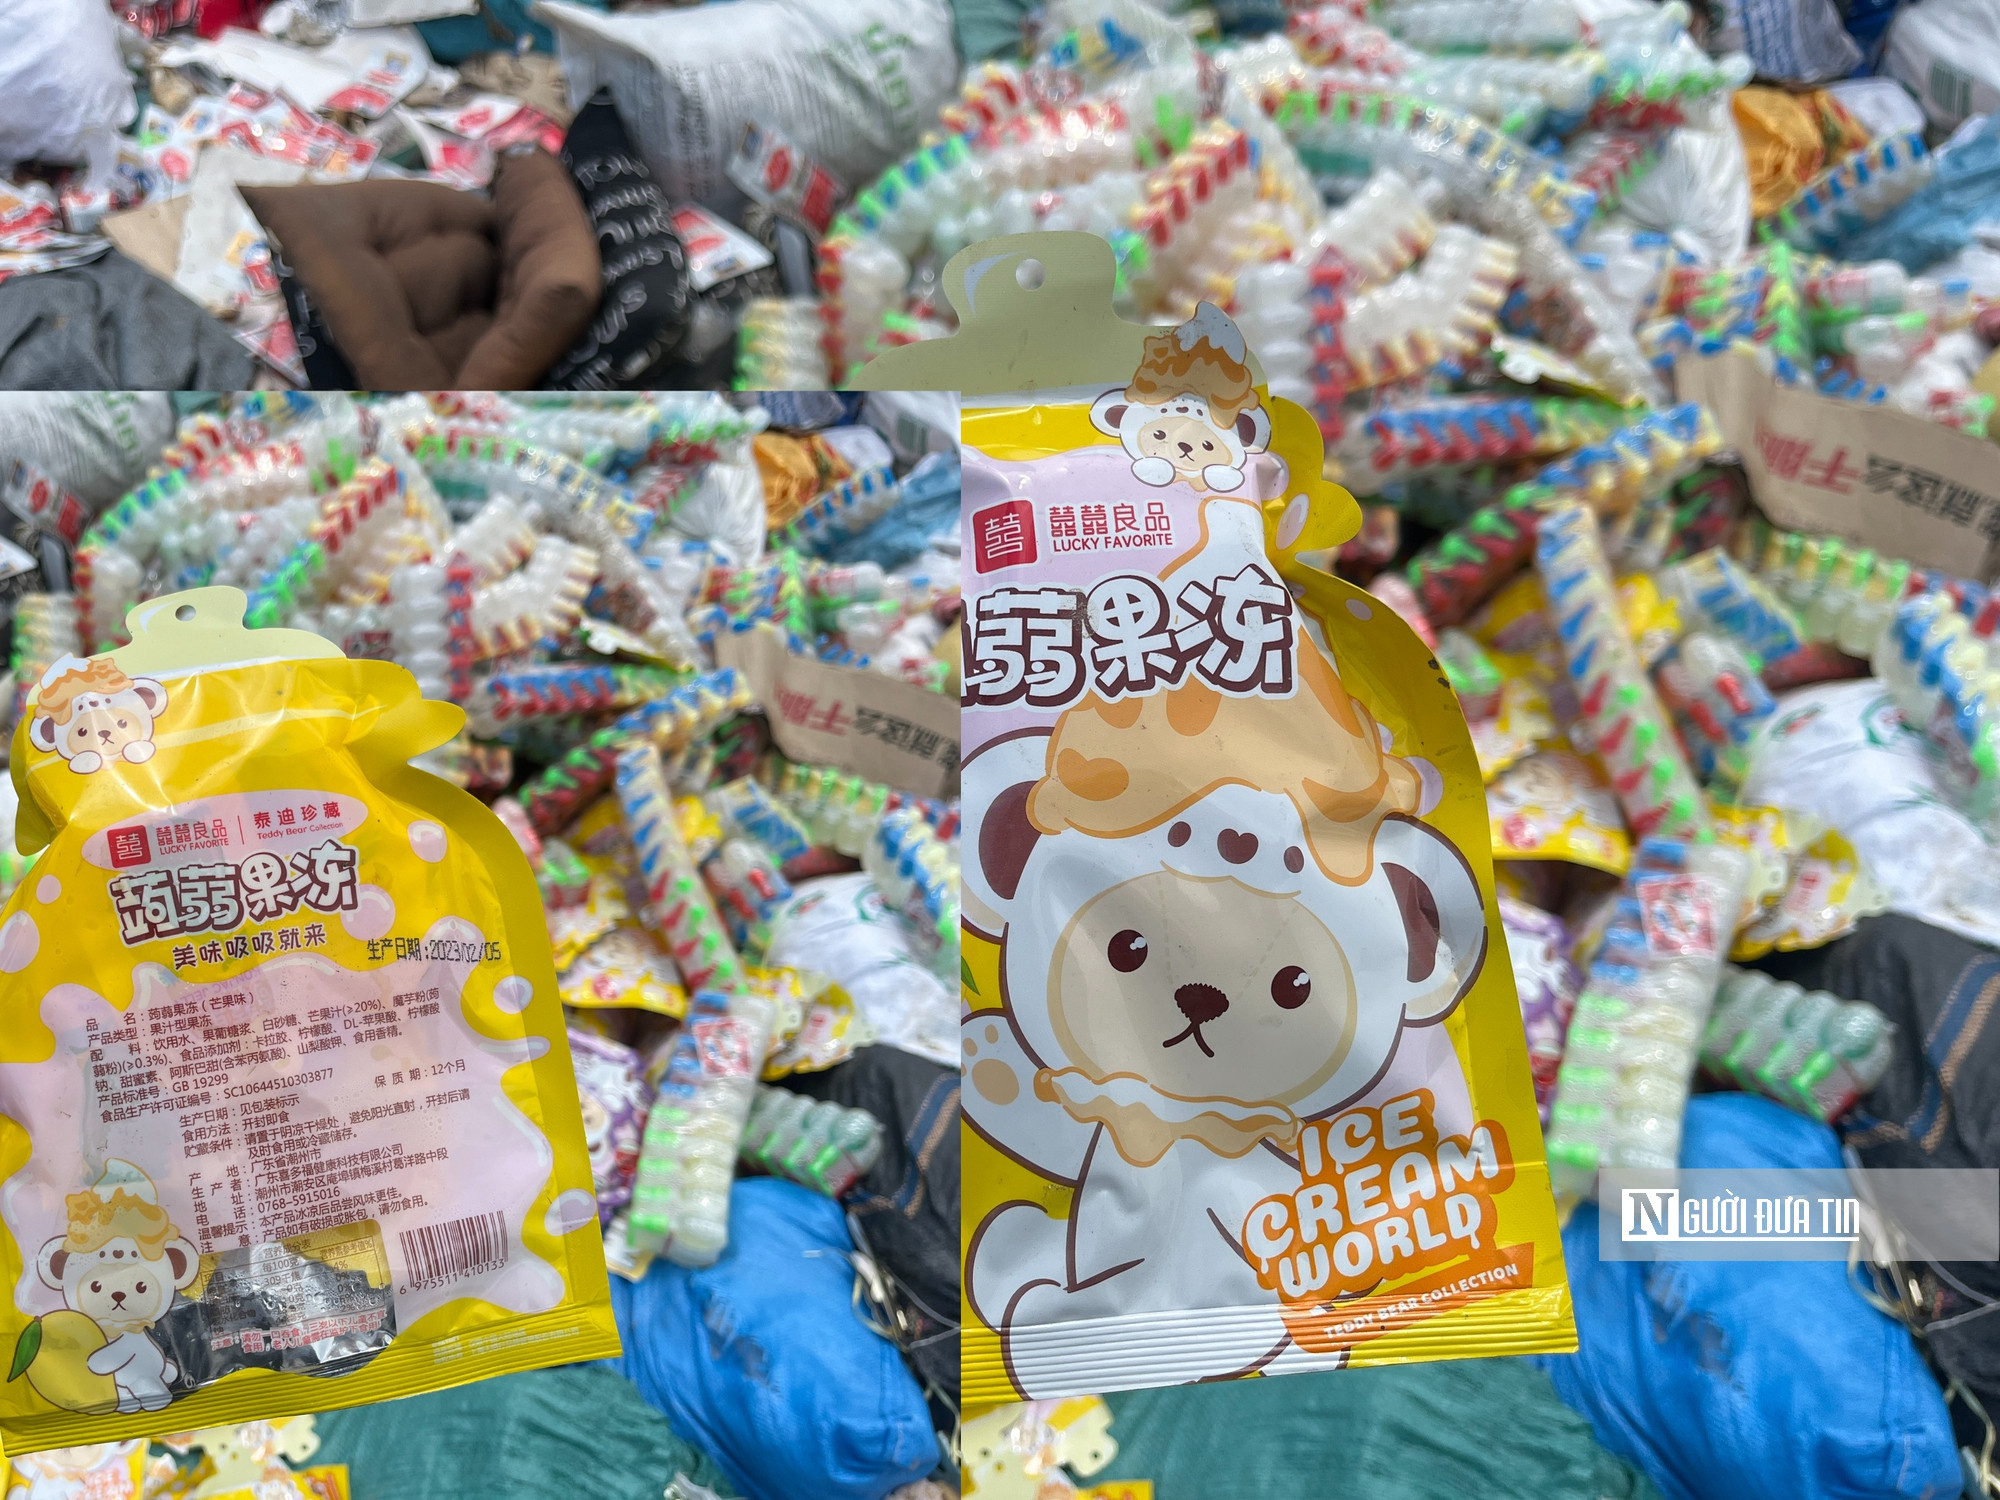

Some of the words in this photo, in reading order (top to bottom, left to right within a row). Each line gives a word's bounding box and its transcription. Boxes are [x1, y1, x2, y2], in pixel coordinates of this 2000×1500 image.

[1053, 537, 1100, 552] LUCKY
[1104, 533, 1173, 549] FAVORITE
[960, 563, 1294, 707] 蒻果冻
[253, 801, 341, 829] 泰迪珍藏
[159, 843, 187, 856] LUCKY
[189, 838, 229, 852] FAVORITE
[257, 830, 283, 841] Teddy
[285, 827, 308, 837] Bear
[309, 822, 344, 832] Collection
[111, 838, 358, 944] 蒟蒻果冻
[172, 923, 326, 970] 美味吸吸就来
[193, 1073, 229, 1090] 19299
[1302, 1095, 1423, 1177] ICE
[1246, 1126, 1499, 1274] CREAM
[263, 1238, 312, 1259] 营养成分表
[1278, 1193, 1482, 1297] WORLD
[262, 1256, 300, 1272] 每100克
[333, 1260, 348, 1271] 4%
[399, 1285, 407, 1295] 6
[414, 1273, 458, 1292] 975511
[464, 1258, 505, 1279] 410133
[1323, 1313, 1375, 1339] TEDDY
[1377, 1297, 1419, 1321] BEAR
[1421, 1263, 1519, 1305] COLLECTION
